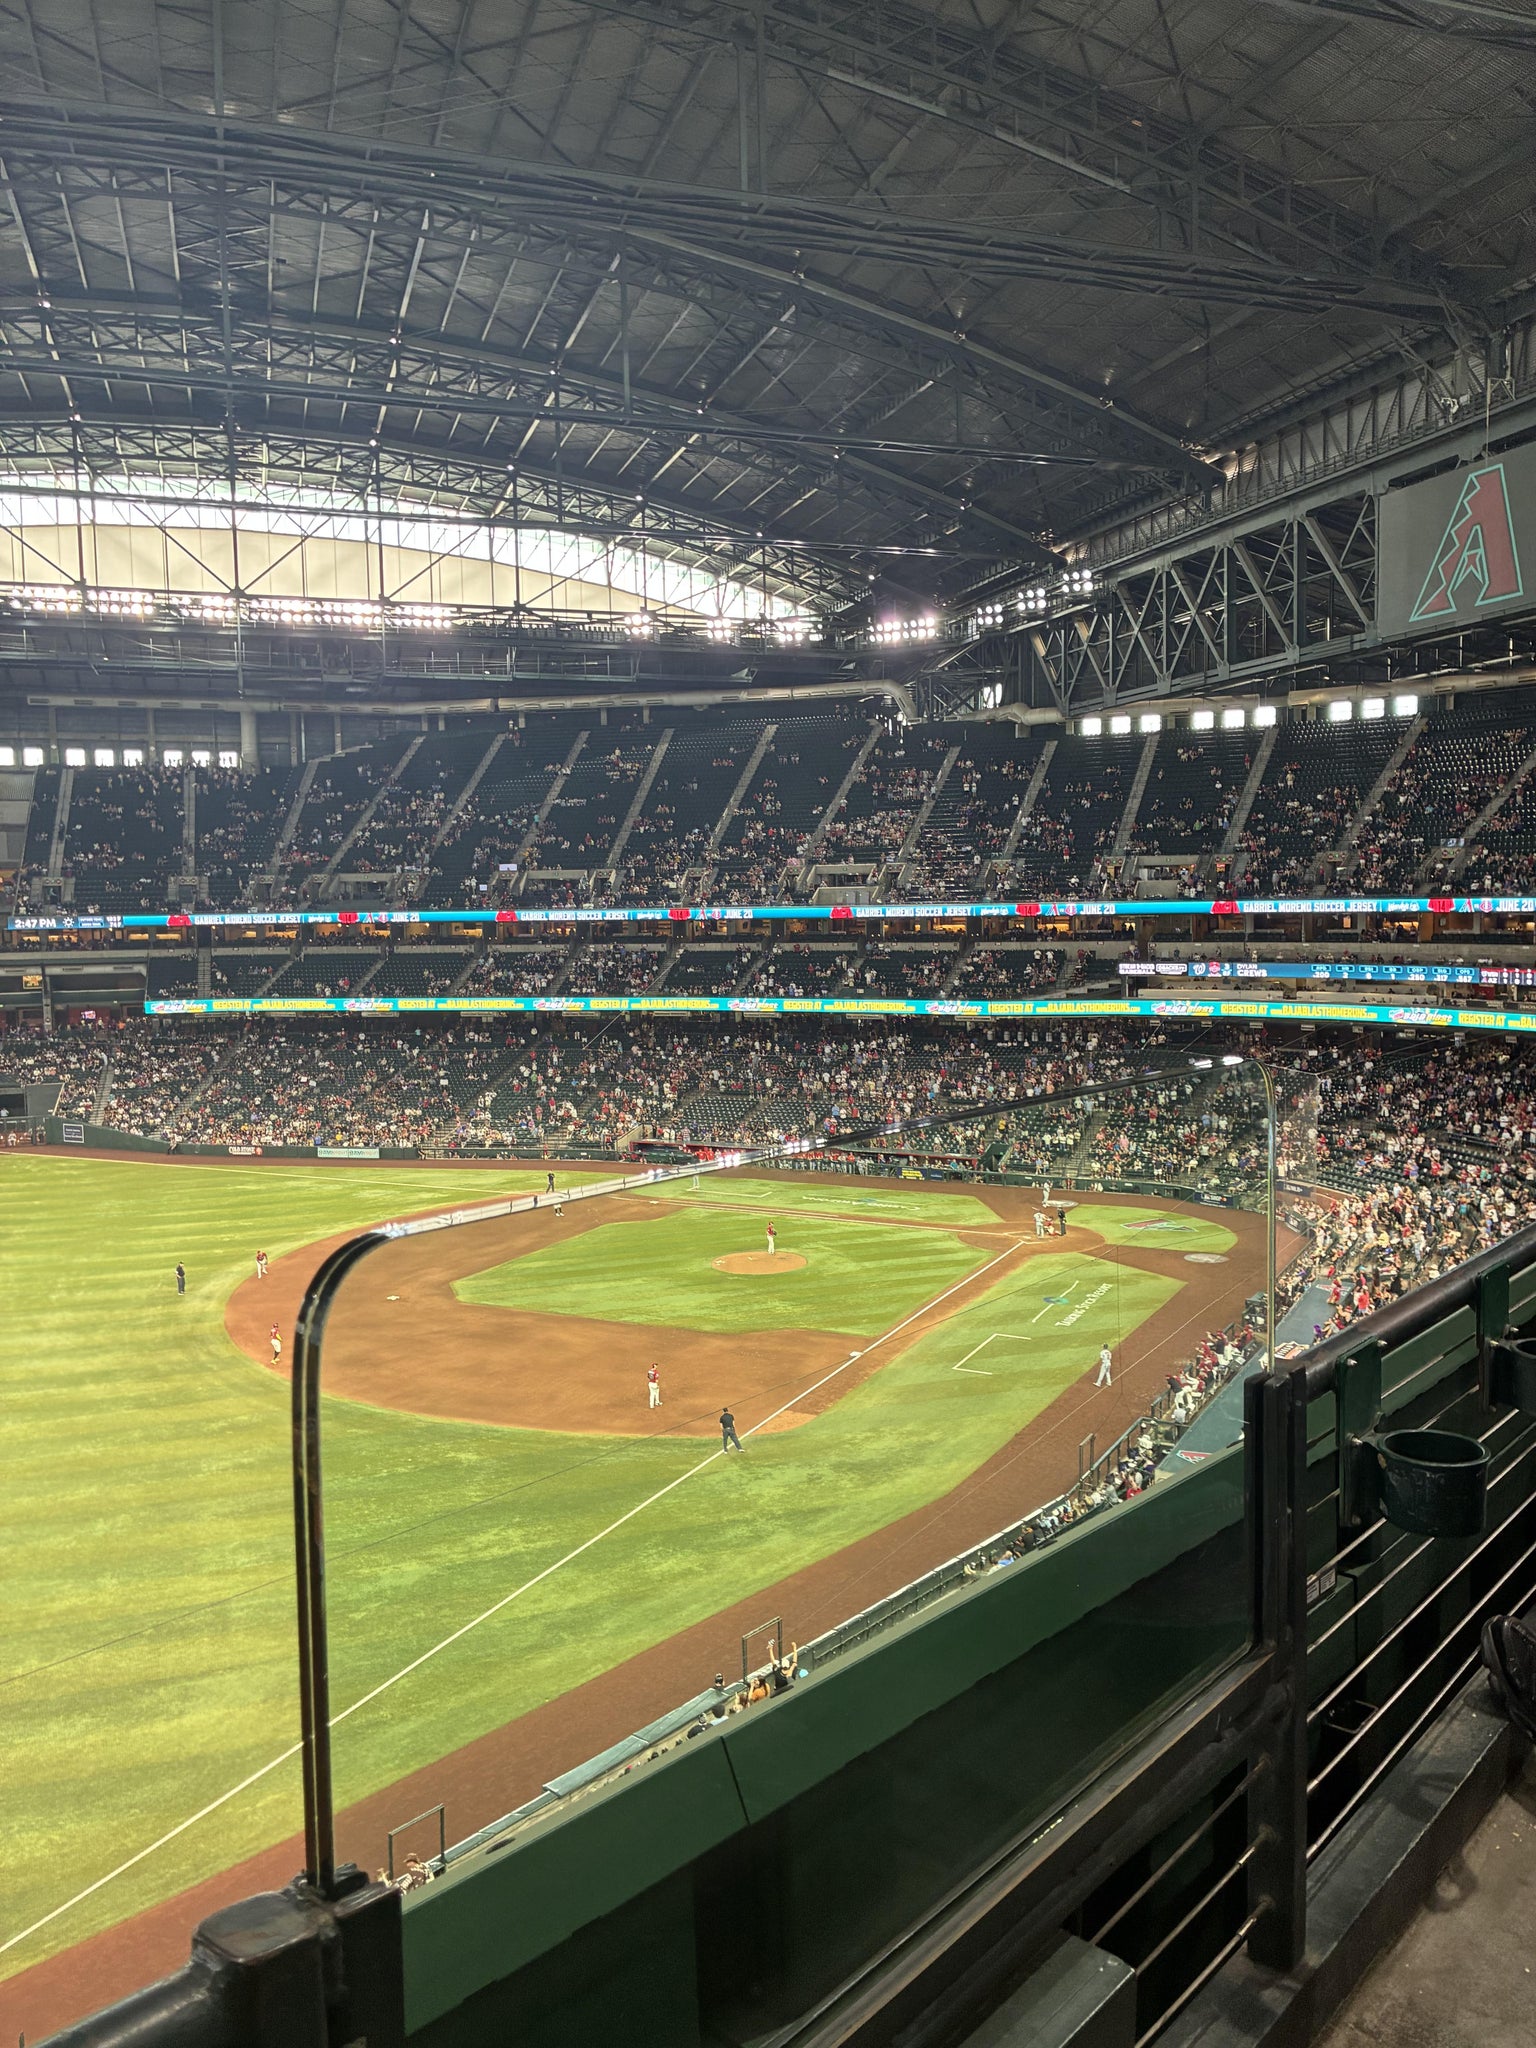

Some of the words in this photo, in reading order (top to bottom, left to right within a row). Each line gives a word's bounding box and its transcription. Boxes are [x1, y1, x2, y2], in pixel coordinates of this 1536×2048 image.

[1080, 905, 1102, 915] JUNE
[1103, 905, 1115, 914] 20
[1244, 902, 1276, 912] GABRIEL
[1278, 902, 1311, 912] MORENO
[1314, 902, 1345, 912] SOCCER
[1347, 901, 1376, 911] JERSEY
[1496, 900, 1520, 911] JUNE
[1521, 900, 1534, 911] 20
[521, 912, 548, 921] GABRIEL
[577, 911, 602, 920] SOCCER
[604, 911, 628, 920] JERSEY
[724, 910, 742, 919] JUNE
[743, 910, 753, 918] 20
[856, 908, 884, 917] GABRIEL
[886, 908, 913, 917] MORENO
[915, 908, 943, 917] SOCCER
[944, 907, 971, 916] JERSEY
[253, 915, 276, 923] SOCCER
[278, 915, 300, 923] JERSEY
[391, 914, 409, 922] JUNE
[410, 914, 420, 922] 20
[15, 919, 37, 928] 2:47
[39, 918, 56, 928] PM
[213, 1001, 243, 1009] REGISTER
[244, 1001, 250, 1009] AT
[398, 1000, 427, 1008] REGISTER
[428, 1000, 435, 1008] AT
[590, 1000, 620, 1008] REGISTER
[621, 1000, 628, 1008] AT
[783, 1001, 813, 1010] REGISTER
[813, 1001, 821, 1010] AT
[988, 1003, 1023, 1012] REGISTER
[1025, 1004, 1033, 1012] AT
[1221, 1004, 1257, 1014] REGISTER
[1258, 1005, 1268, 1014] AT
[1458, 1013, 1495, 1025] REGISTER
[1496, 1015, 1506, 1026] AT
